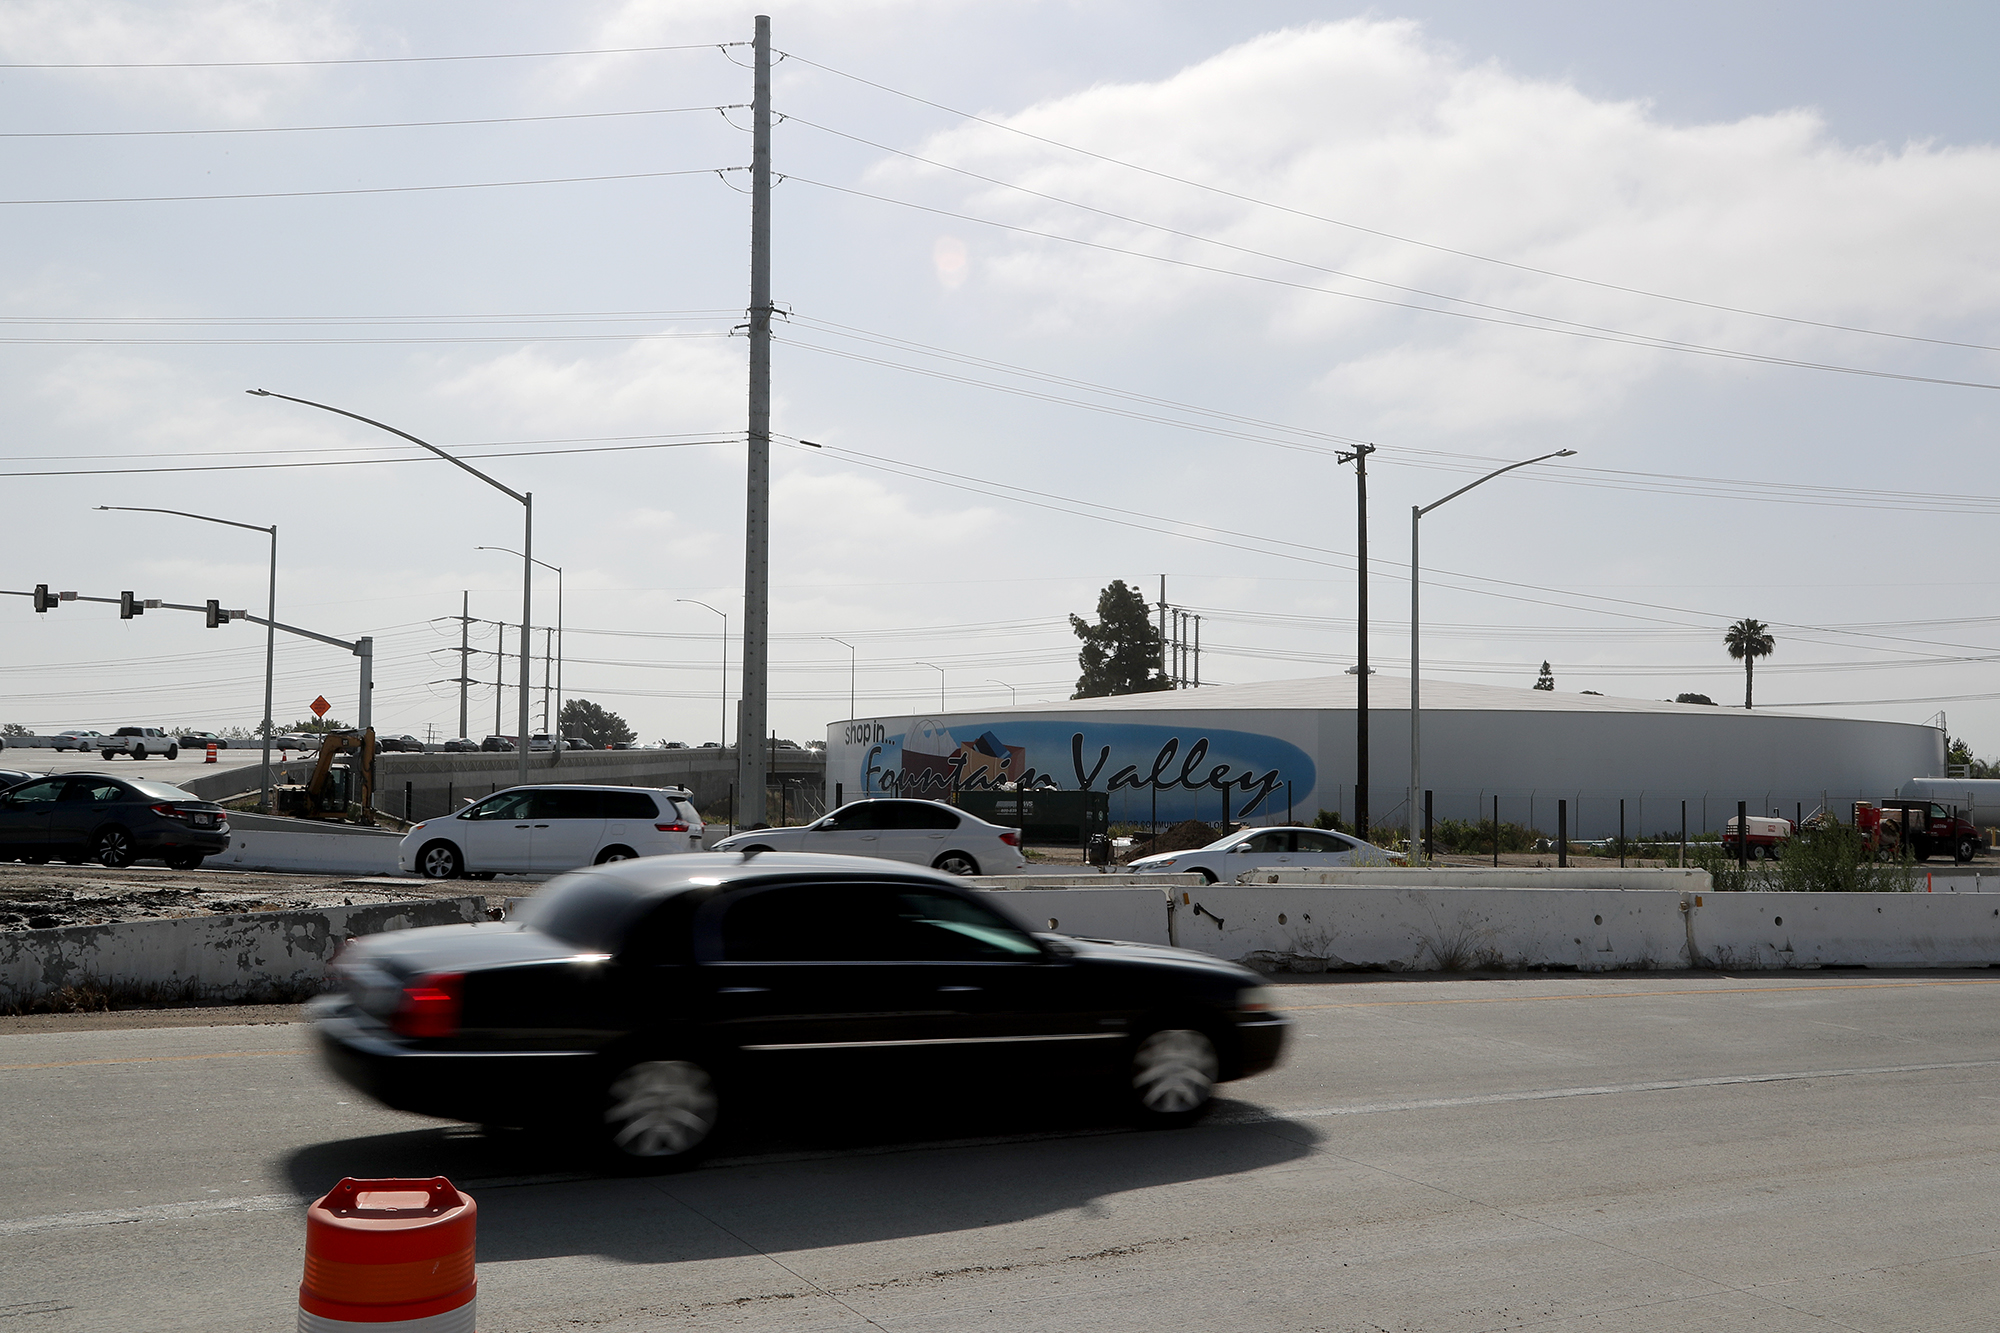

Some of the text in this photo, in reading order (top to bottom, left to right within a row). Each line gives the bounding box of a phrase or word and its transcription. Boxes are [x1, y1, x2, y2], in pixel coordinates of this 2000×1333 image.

[845, 719, 895, 747] shop in...
[865, 732, 1284, 819] Fountain Valley
